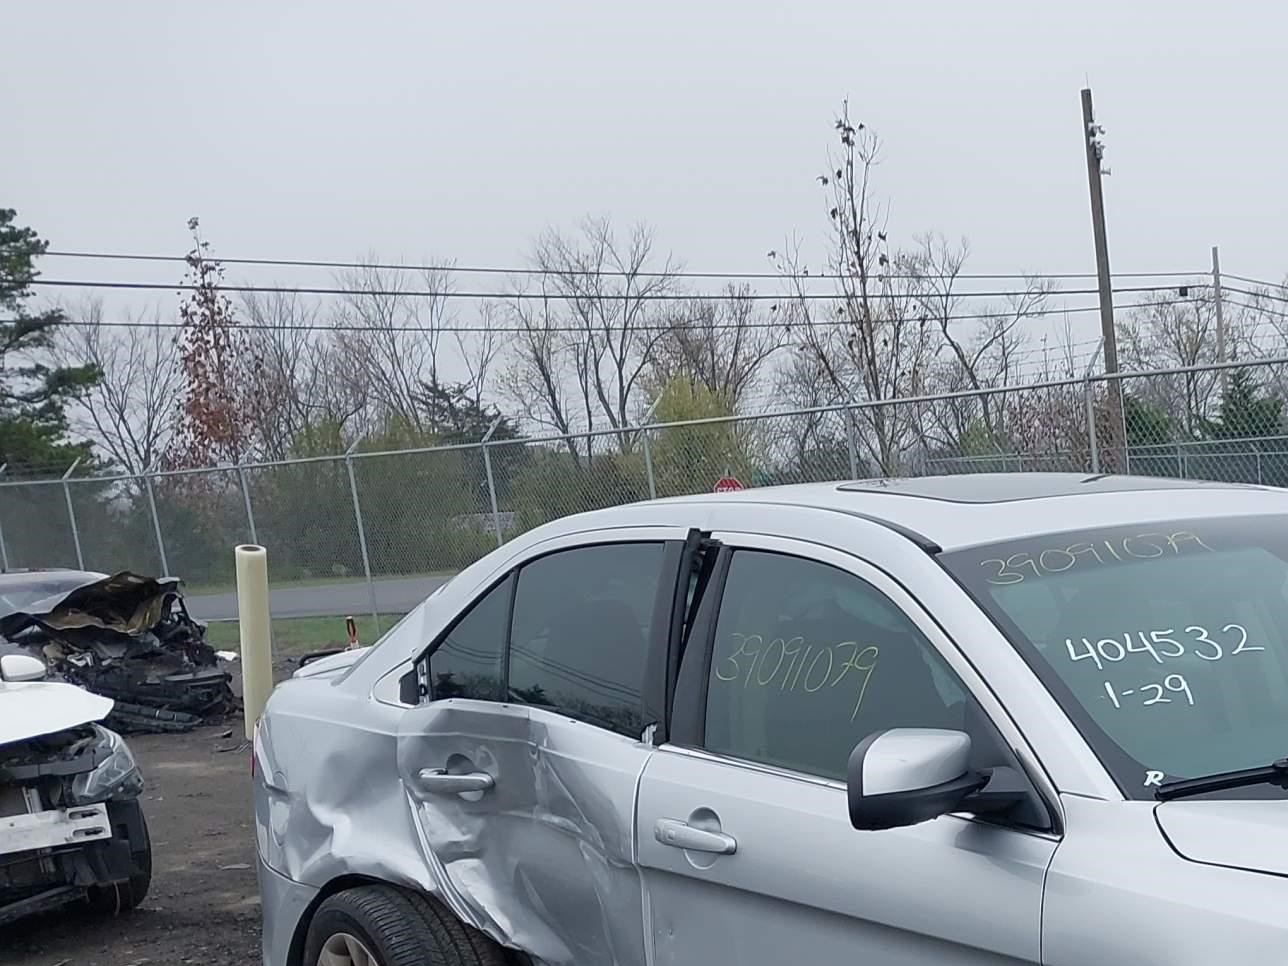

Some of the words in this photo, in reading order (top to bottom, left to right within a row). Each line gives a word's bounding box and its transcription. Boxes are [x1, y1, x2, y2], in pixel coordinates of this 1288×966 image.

[1064, 623, 1265, 670] 404532
[715, 632, 879, 722] 39091079
[1103, 674, 1195, 708] 1-29
[1143, 770, 1165, 787] R
